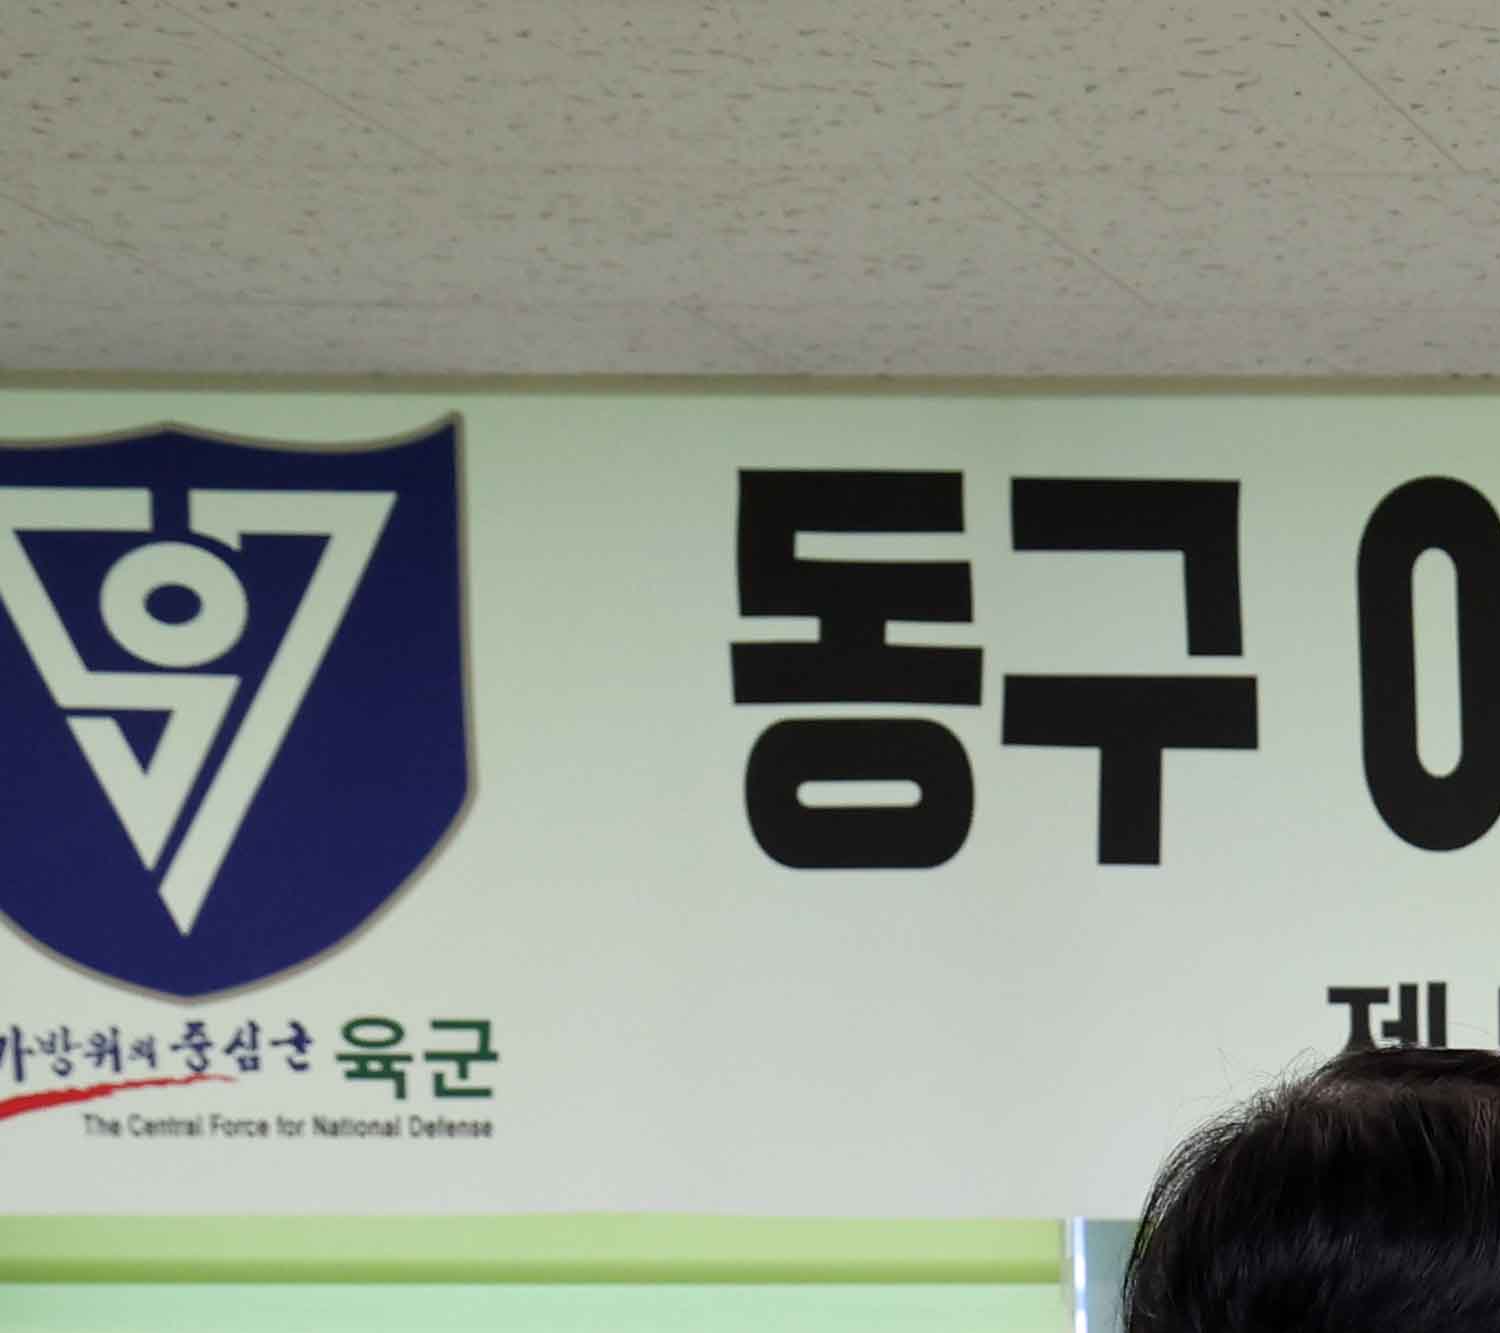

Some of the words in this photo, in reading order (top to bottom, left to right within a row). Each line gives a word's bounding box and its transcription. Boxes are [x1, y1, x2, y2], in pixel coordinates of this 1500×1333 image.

[731, 469, 1259, 871] 동구
[336, 1017, 501, 1101] 육군
[84, 1114, 124, 1138] The
[128, 1114, 203, 1139] Central
[210, 1114, 270, 1139] Force
[276, 1115, 306, 1139] for
[312, 1115, 402, 1140] National
[409, 1115, 495, 1140] Defense
